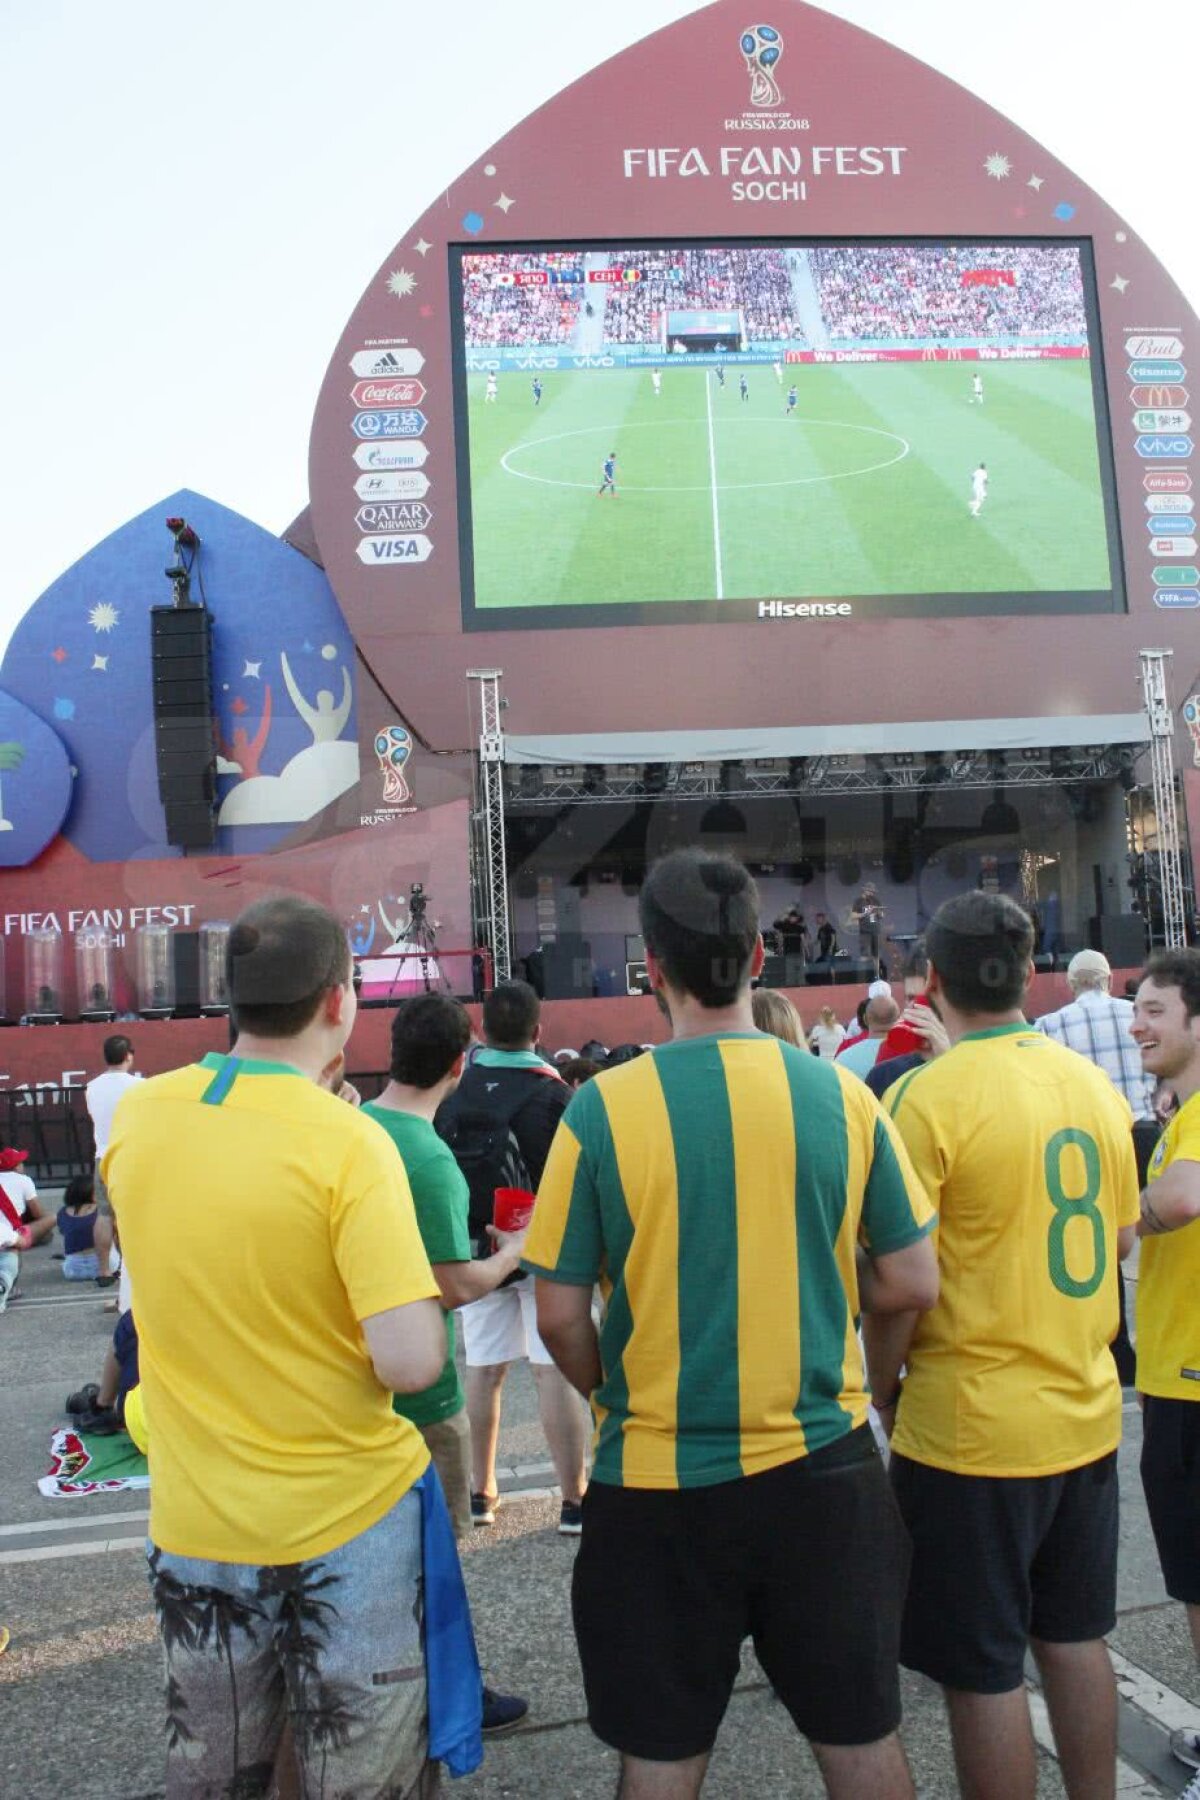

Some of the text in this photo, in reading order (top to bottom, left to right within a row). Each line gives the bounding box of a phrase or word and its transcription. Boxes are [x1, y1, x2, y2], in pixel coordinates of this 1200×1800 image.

[725, 119, 810, 130] RUSSIA 2018
[623, 146, 908, 178] FIFA FAN FEST
[732, 181, 807, 201] SOCHI
[813, 352, 832, 362] We
[836, 351, 878, 362] Deliver
[383, 426, 419, 435] WANDA
[361, 504, 422, 523] QATAR
[377, 519, 423, 530] AIRWAYS
[368, 540, 419, 558] VISA
[4, 904, 196, 935] FIFA FAN FEST
[76, 933, 126, 949] SOCHI
[1044, 1127, 1107, 1298] 8
